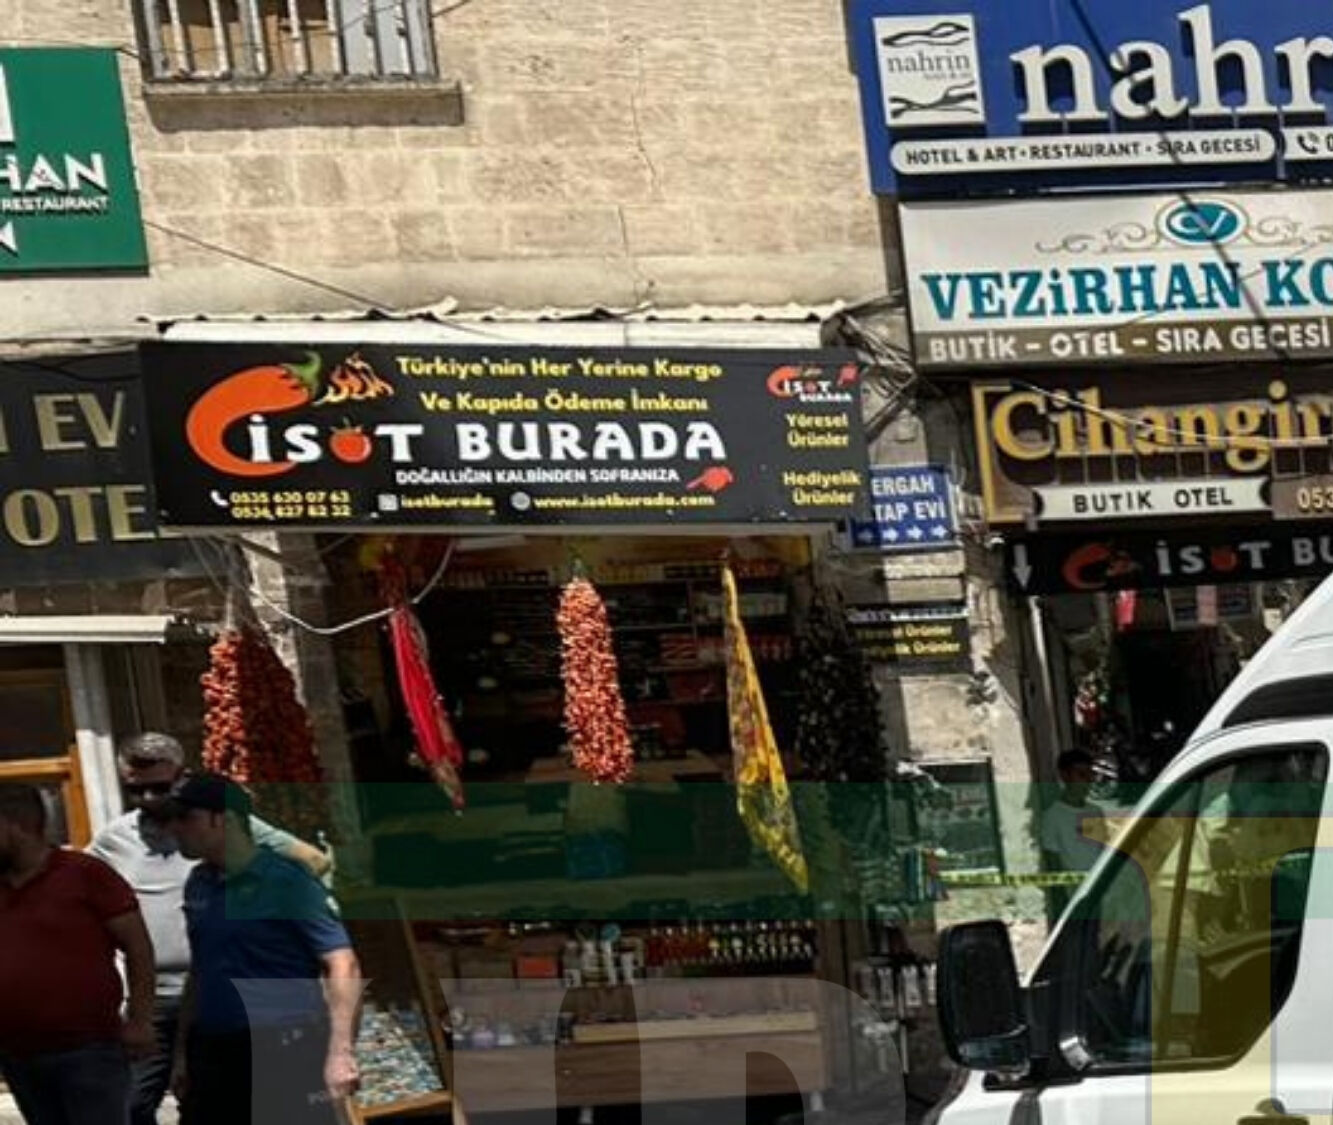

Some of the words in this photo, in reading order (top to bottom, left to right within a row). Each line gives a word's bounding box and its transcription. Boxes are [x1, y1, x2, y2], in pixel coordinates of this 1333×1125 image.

[888, 49, 970, 74] nahrin
[906, 148, 963, 165] HOTEL
[984, 146, 1016, 161] ART
[1029, 141, 1141, 160] RESTAURANT
[929, 331, 1018, 363] BUTİK
[1050, 331, 1125, 358] OTEL
[1156, 327, 1223, 352] SIRA
[1230, 317, 1331, 349] GECESİ
[396, 356, 526, 380] Türkiye'nin
[532, 358, 571, 377] Her
[577, 358, 648, 378] Yerine
[654, 357, 723, 382] Kargo
[420, 392, 451, 411] Ve
[545, 388, 626, 412] Ödeme
[33, 390, 125, 451] EV
[992, 380, 1331, 472] Cihangir
[456, 421, 726, 462] BURADA
[1174, 487, 1233, 509] OTEL
[4, 483, 160, 547] OTE
